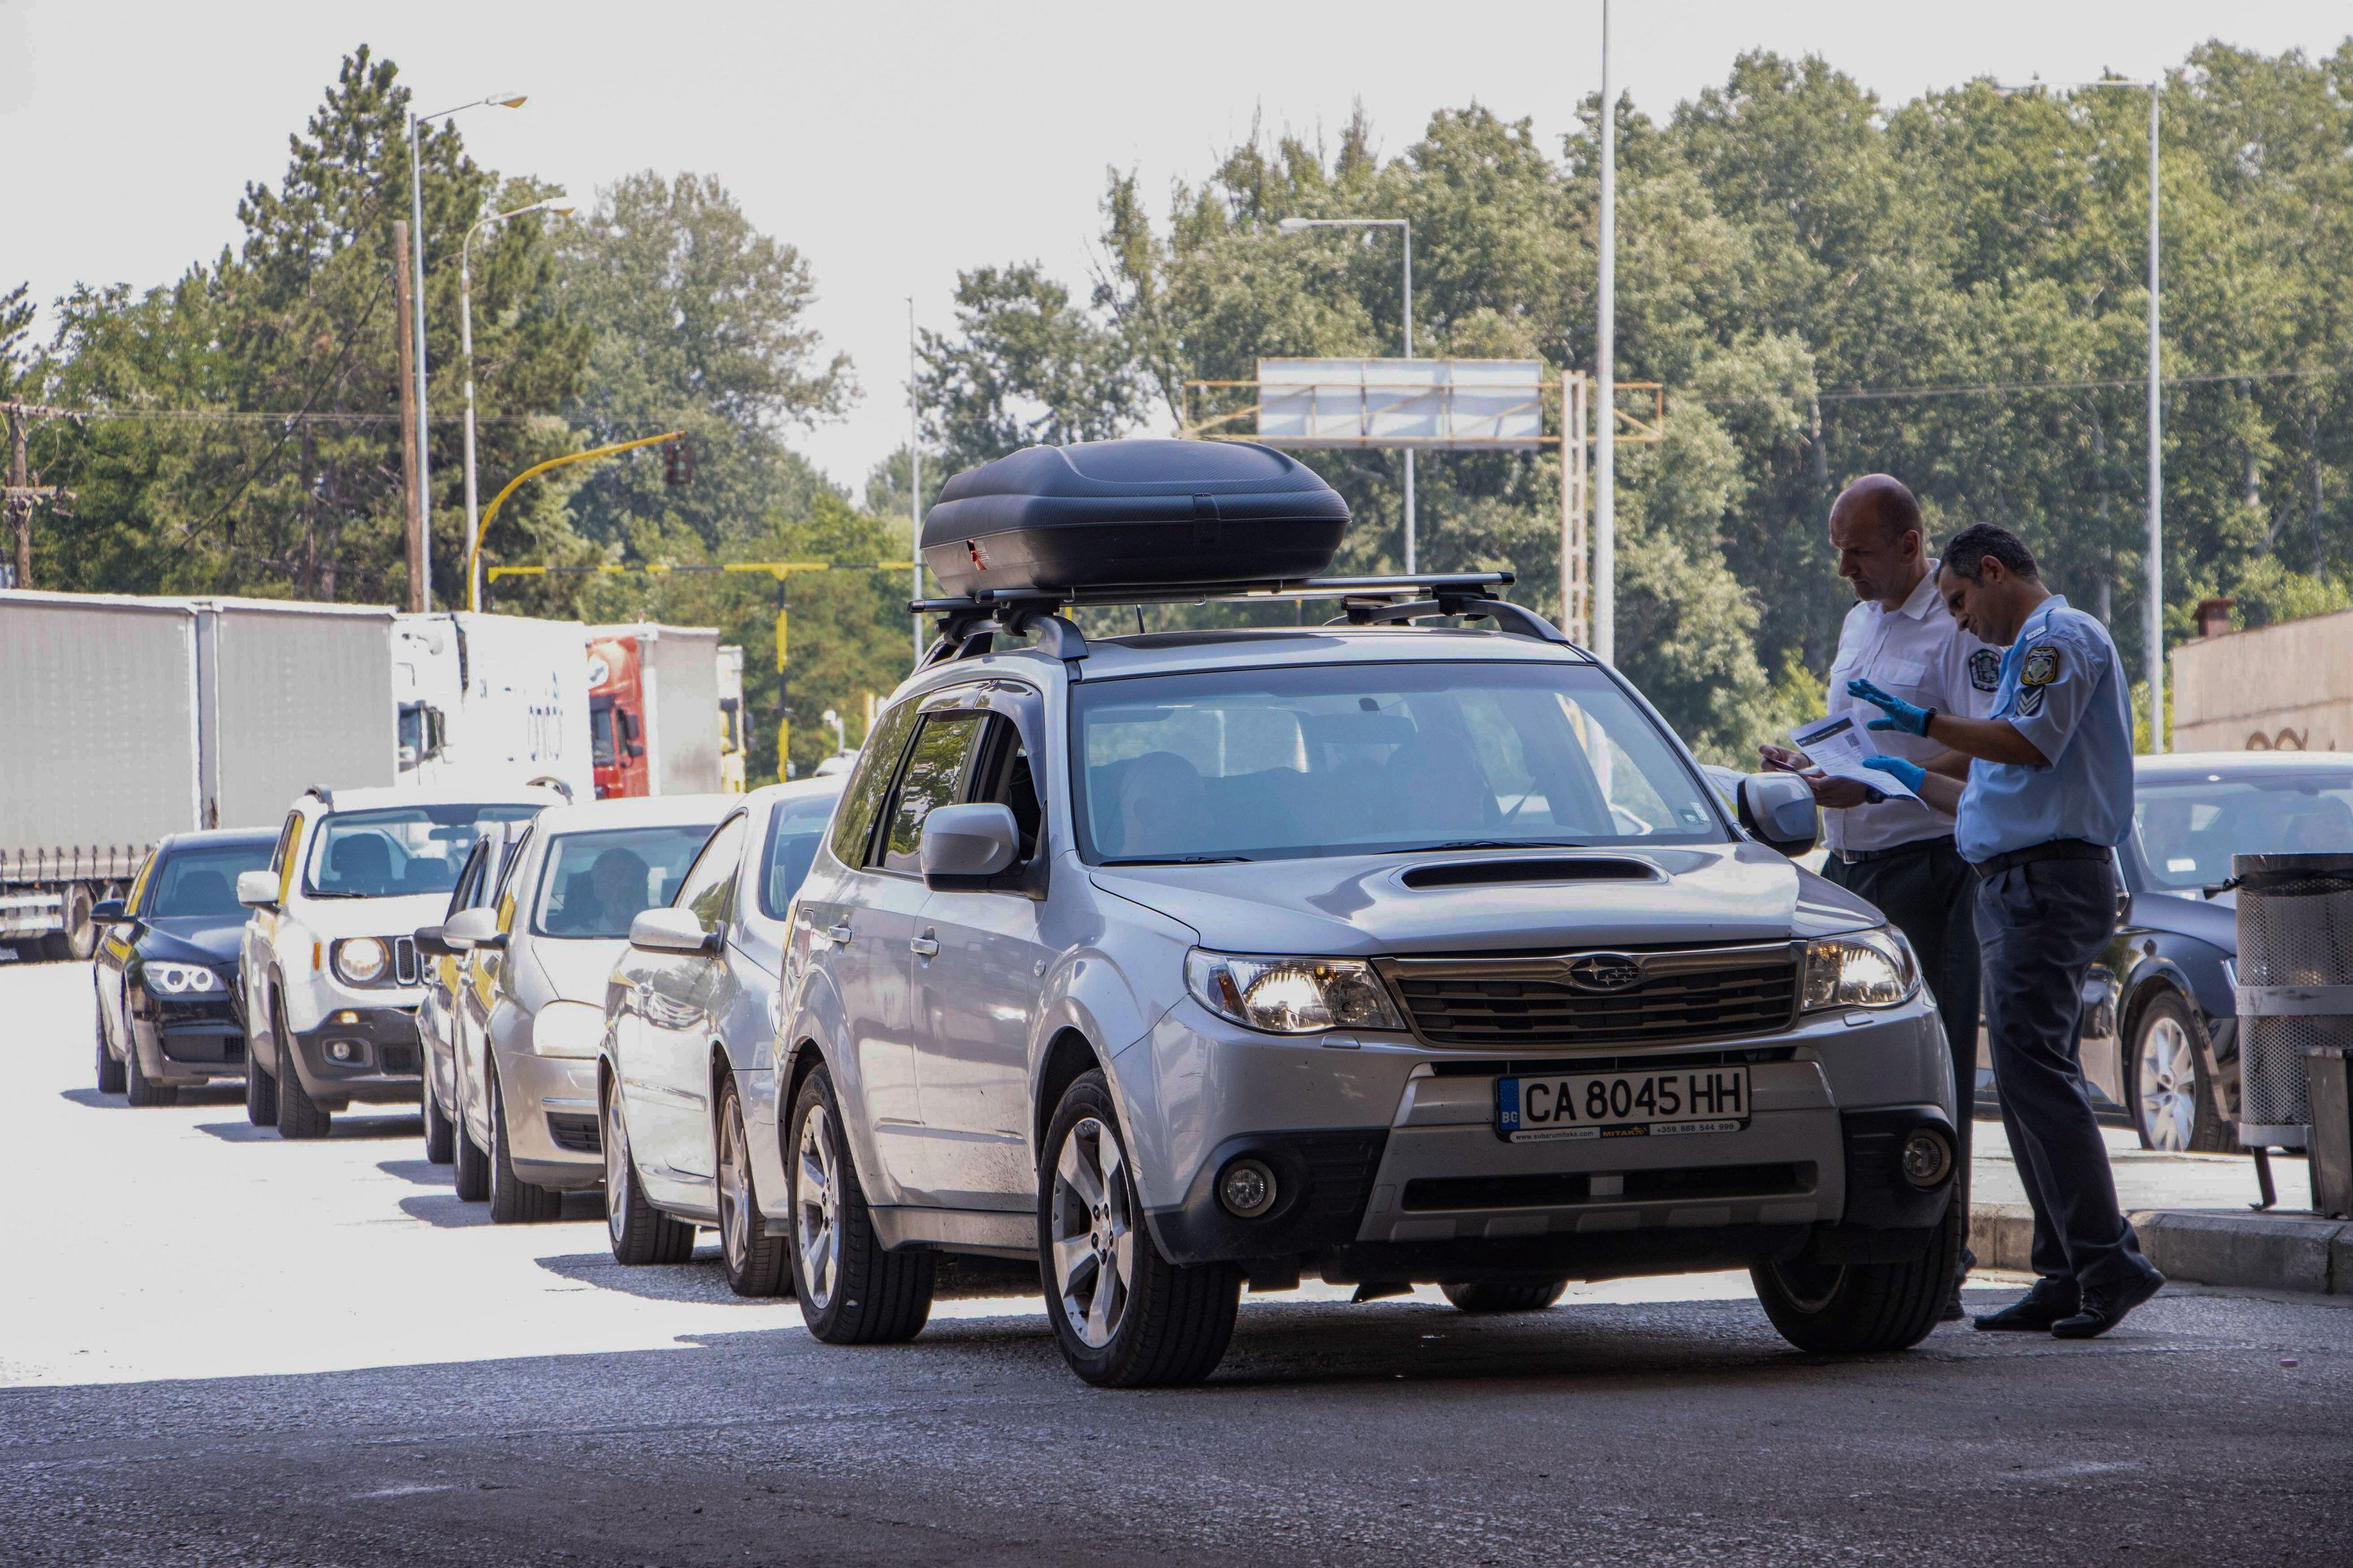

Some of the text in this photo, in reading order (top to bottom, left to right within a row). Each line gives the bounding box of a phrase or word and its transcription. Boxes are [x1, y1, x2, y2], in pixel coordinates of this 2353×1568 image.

[1526, 1073, 1741, 1122] CA 8045 HH
[1502, 1111, 1518, 1123] BG
[1516, 1131, 1594, 1140] www.subarumitaka.com
[1602, 1129, 1644, 1137] MITAKA
